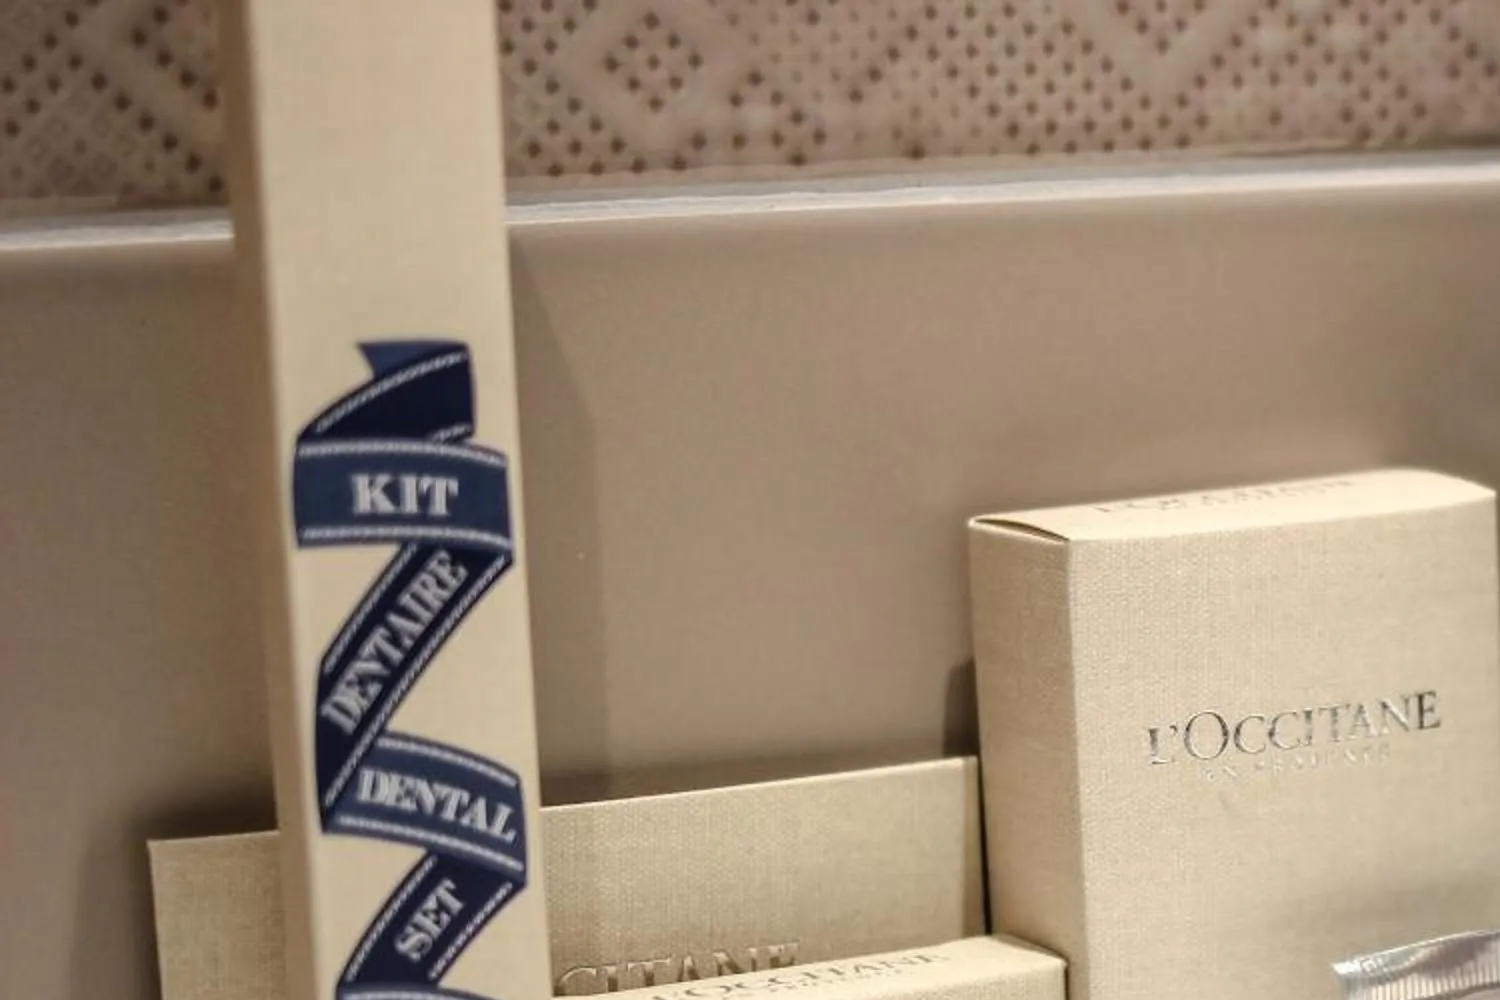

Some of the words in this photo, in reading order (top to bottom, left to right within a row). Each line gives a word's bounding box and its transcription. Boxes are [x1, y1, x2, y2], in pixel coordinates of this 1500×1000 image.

[349, 472, 460, 517] KIT
[320, 549, 469, 735] DENTAIRE
[1146, 690, 1442, 765] L'OCCITANE
[355, 767, 519, 844] DENTAL
[393, 879, 467, 961] SET
